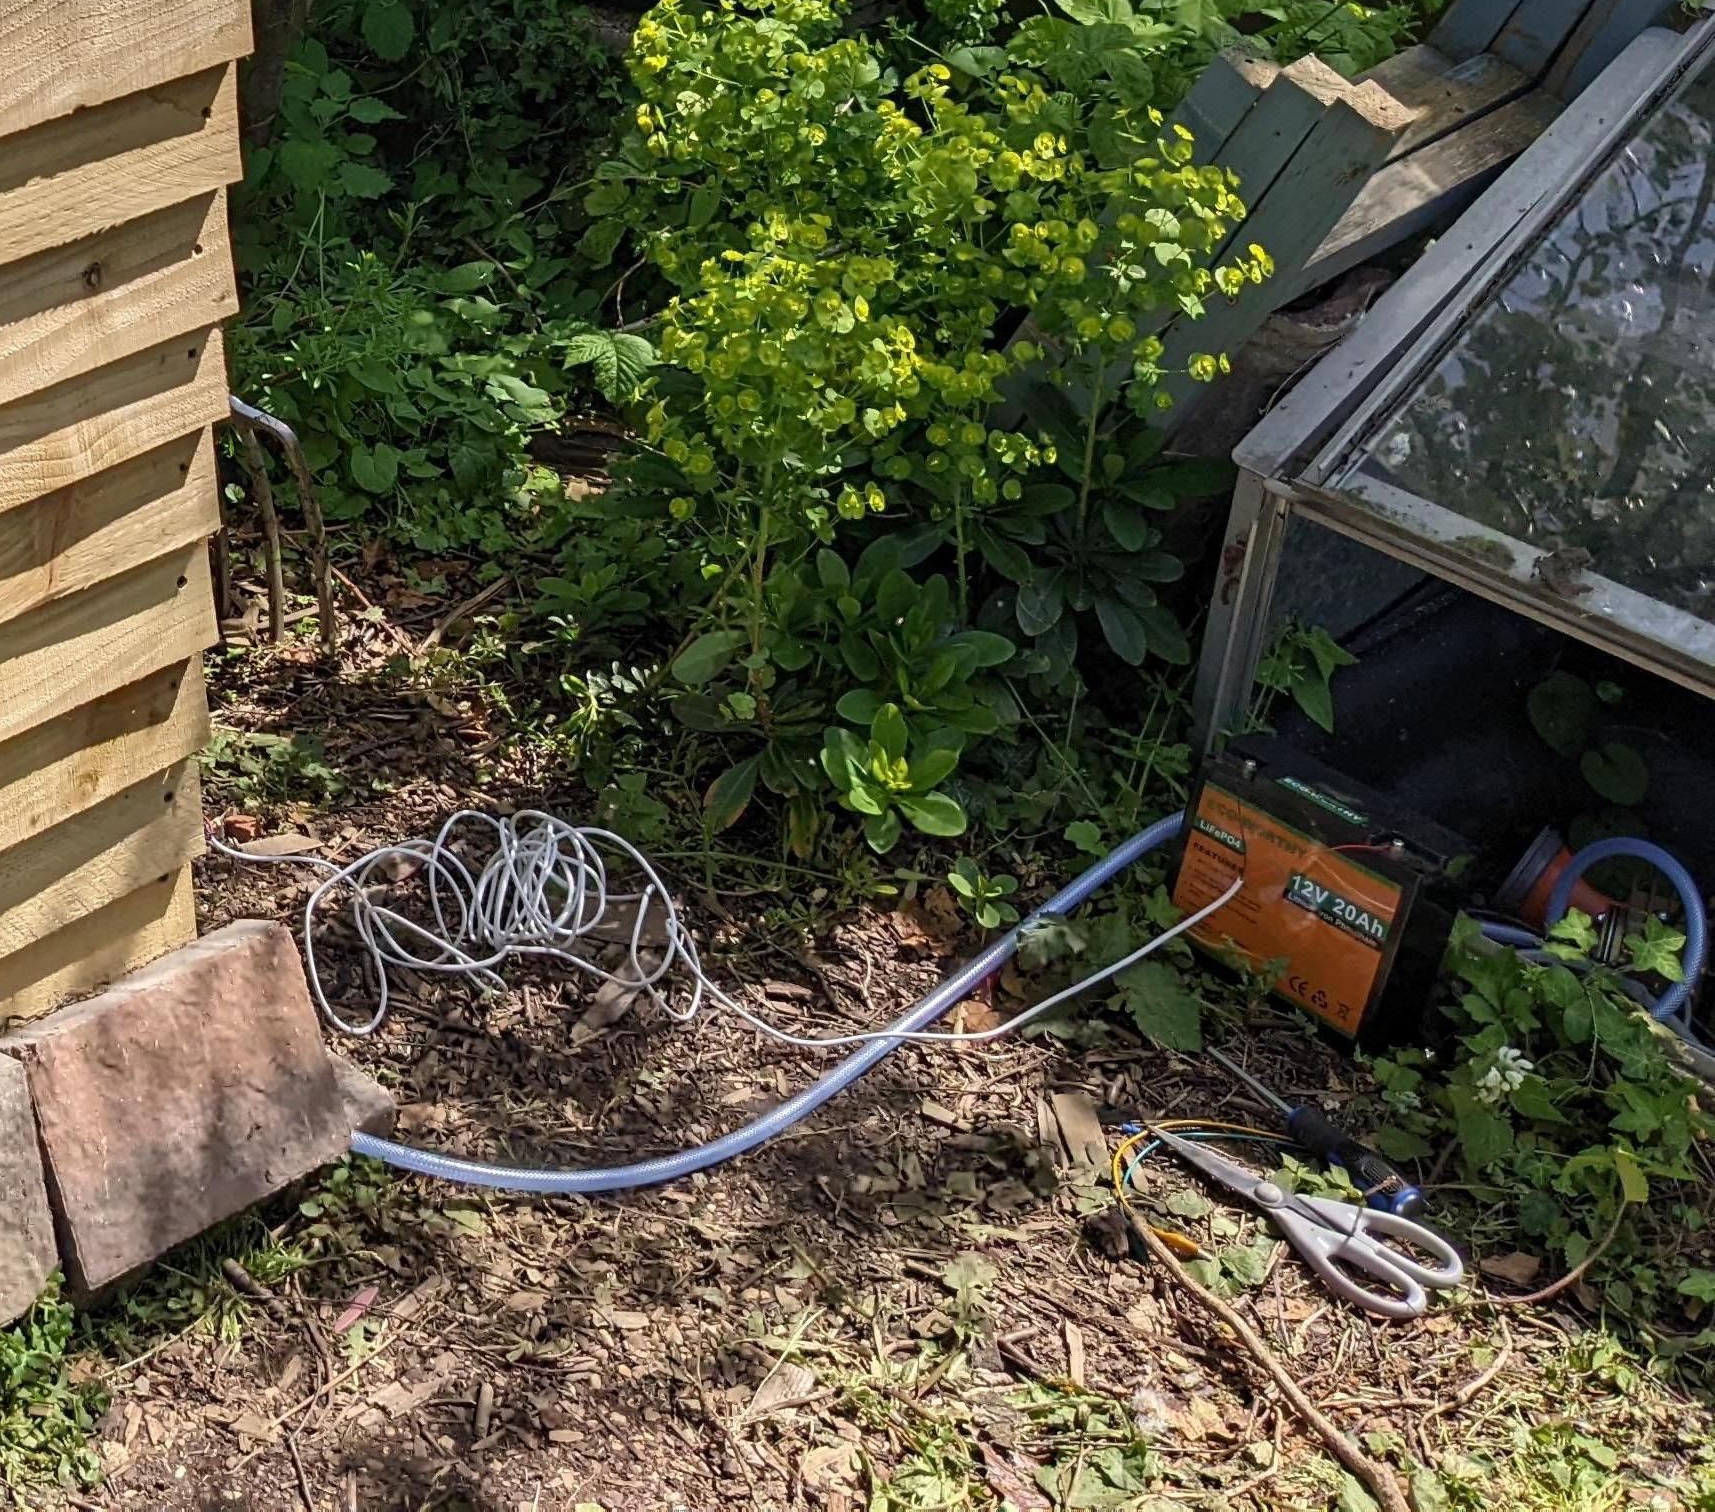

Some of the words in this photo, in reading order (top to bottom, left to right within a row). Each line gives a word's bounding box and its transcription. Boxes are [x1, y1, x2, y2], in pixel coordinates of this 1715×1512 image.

[1200, 820, 1241, 849] LiFePO4
[1292, 875, 1329, 903] 12V
[1333, 898, 1384, 938] 20Ah
